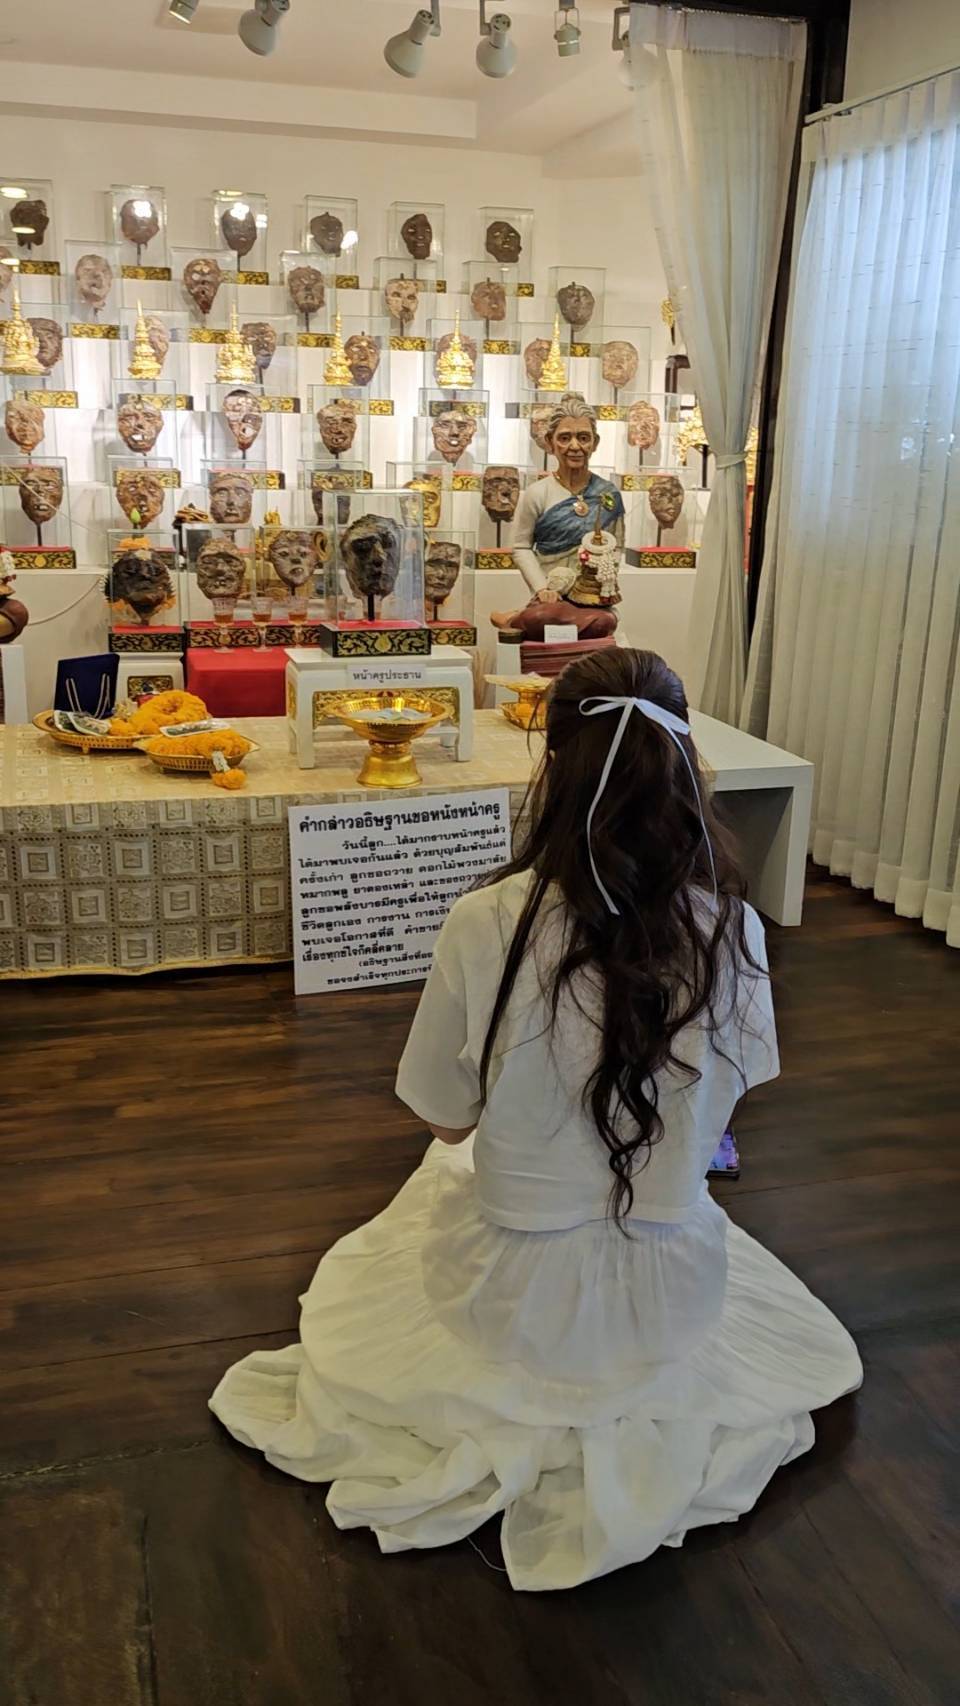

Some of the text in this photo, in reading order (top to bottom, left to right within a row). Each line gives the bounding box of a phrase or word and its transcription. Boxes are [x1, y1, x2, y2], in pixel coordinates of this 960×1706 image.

[352, 669, 421, 683] หน้าครูประธาน
[367, 912, 411, 924] การงาน
